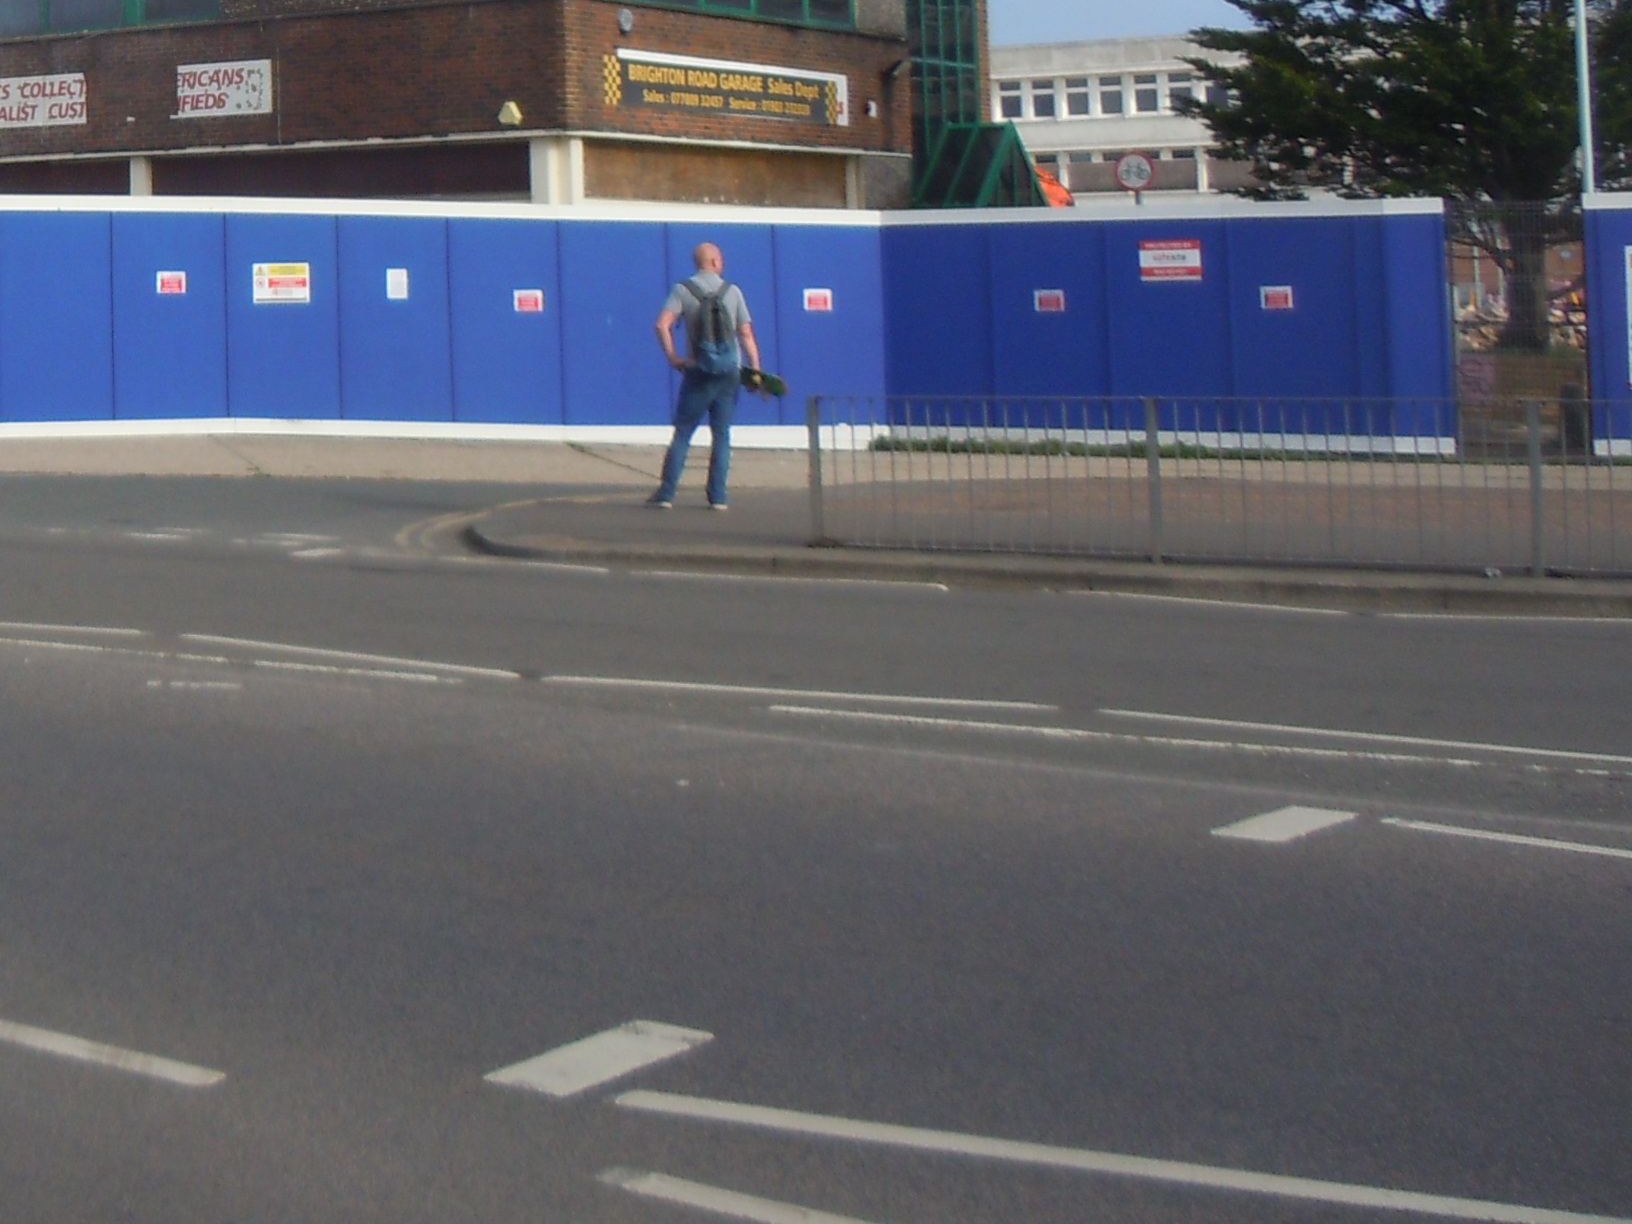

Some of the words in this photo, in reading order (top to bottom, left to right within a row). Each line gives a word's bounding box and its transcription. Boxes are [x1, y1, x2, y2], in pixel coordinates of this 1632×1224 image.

[628, 63, 686, 86] BRIGHTON
[688, 70, 718, 89] ROAD
[719, 73, 764, 93] GARAGE
[768, 77, 794, 96] Sales
[795, 81, 821, 100] Dept
[48, 102, 87, 119] CUST
